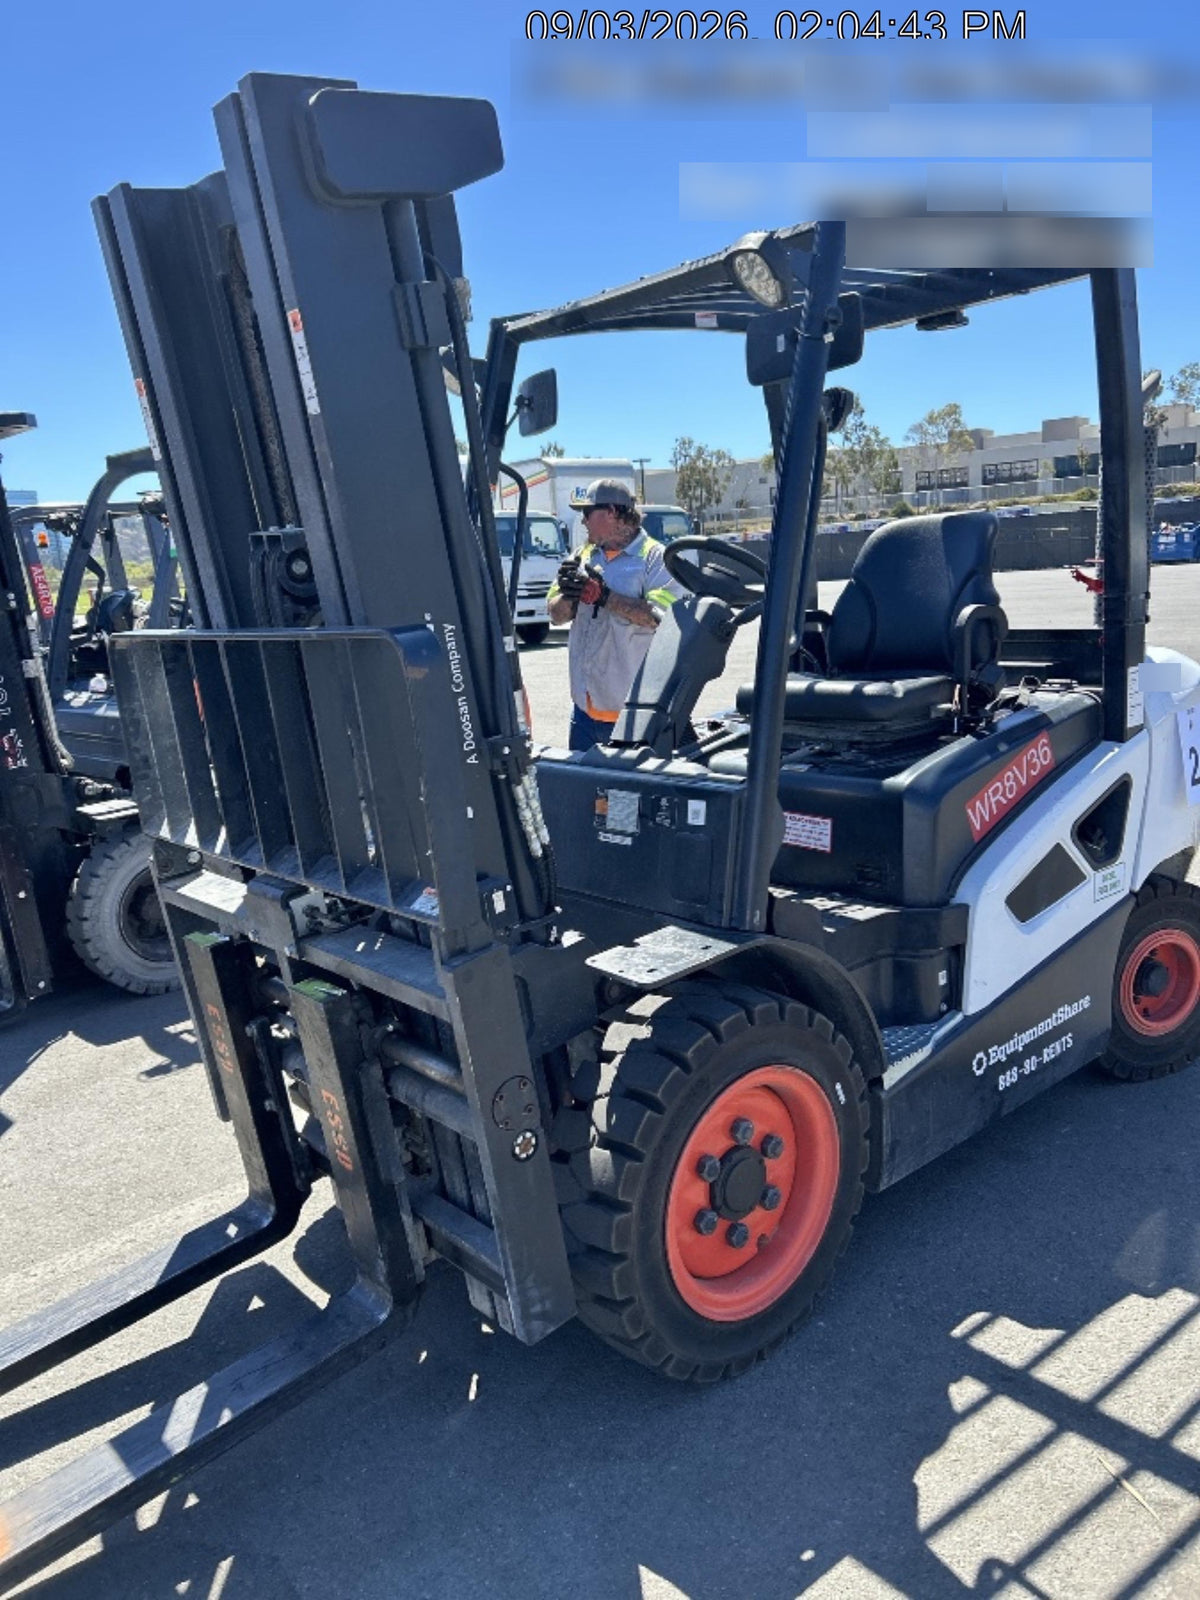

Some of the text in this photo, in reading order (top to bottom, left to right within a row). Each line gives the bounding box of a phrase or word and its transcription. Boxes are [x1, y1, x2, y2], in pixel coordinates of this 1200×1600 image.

[442, 623, 478, 764] A Doosan Company
[966, 738, 1051, 831] WR8V36
[987, 995, 1091, 1065] EquipmentShare
